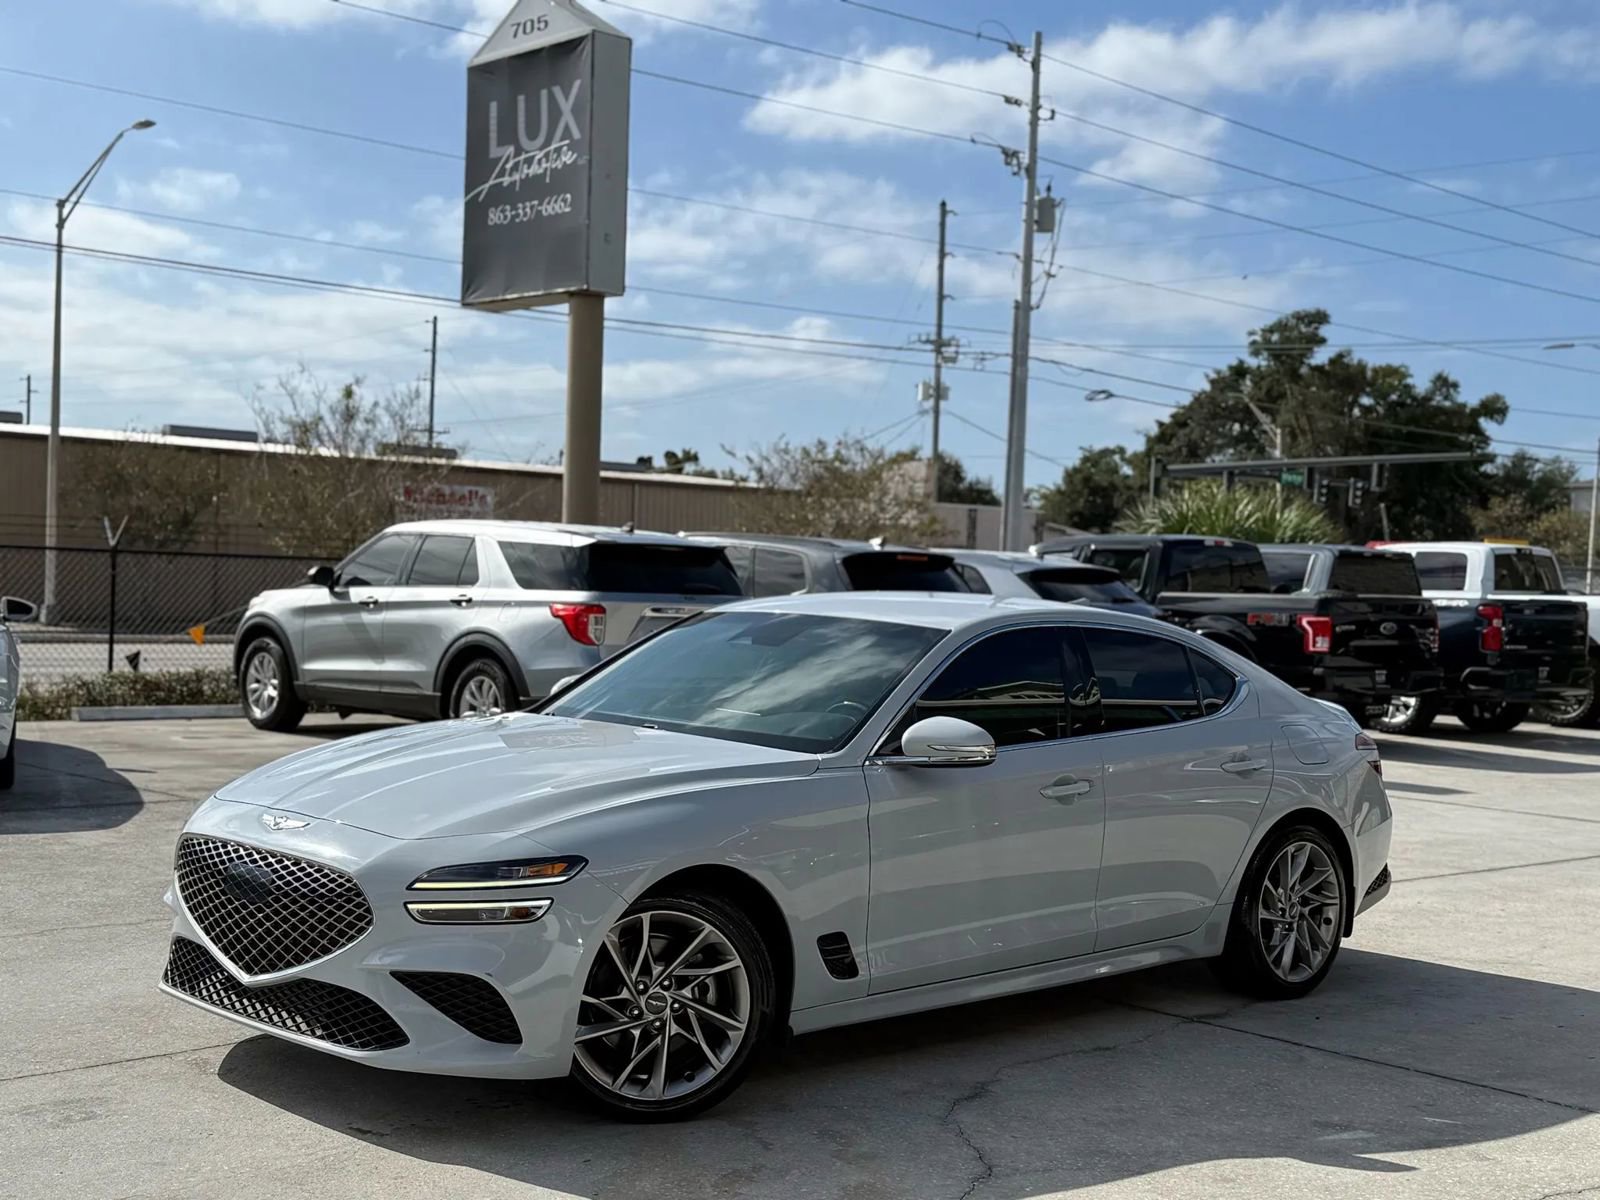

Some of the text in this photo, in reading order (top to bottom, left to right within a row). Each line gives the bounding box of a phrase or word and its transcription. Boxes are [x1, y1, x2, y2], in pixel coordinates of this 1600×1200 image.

[511, 15, 549, 39] 705
[488, 79, 582, 159] LUX
[487, 193, 572, 226] 863-337-6662
